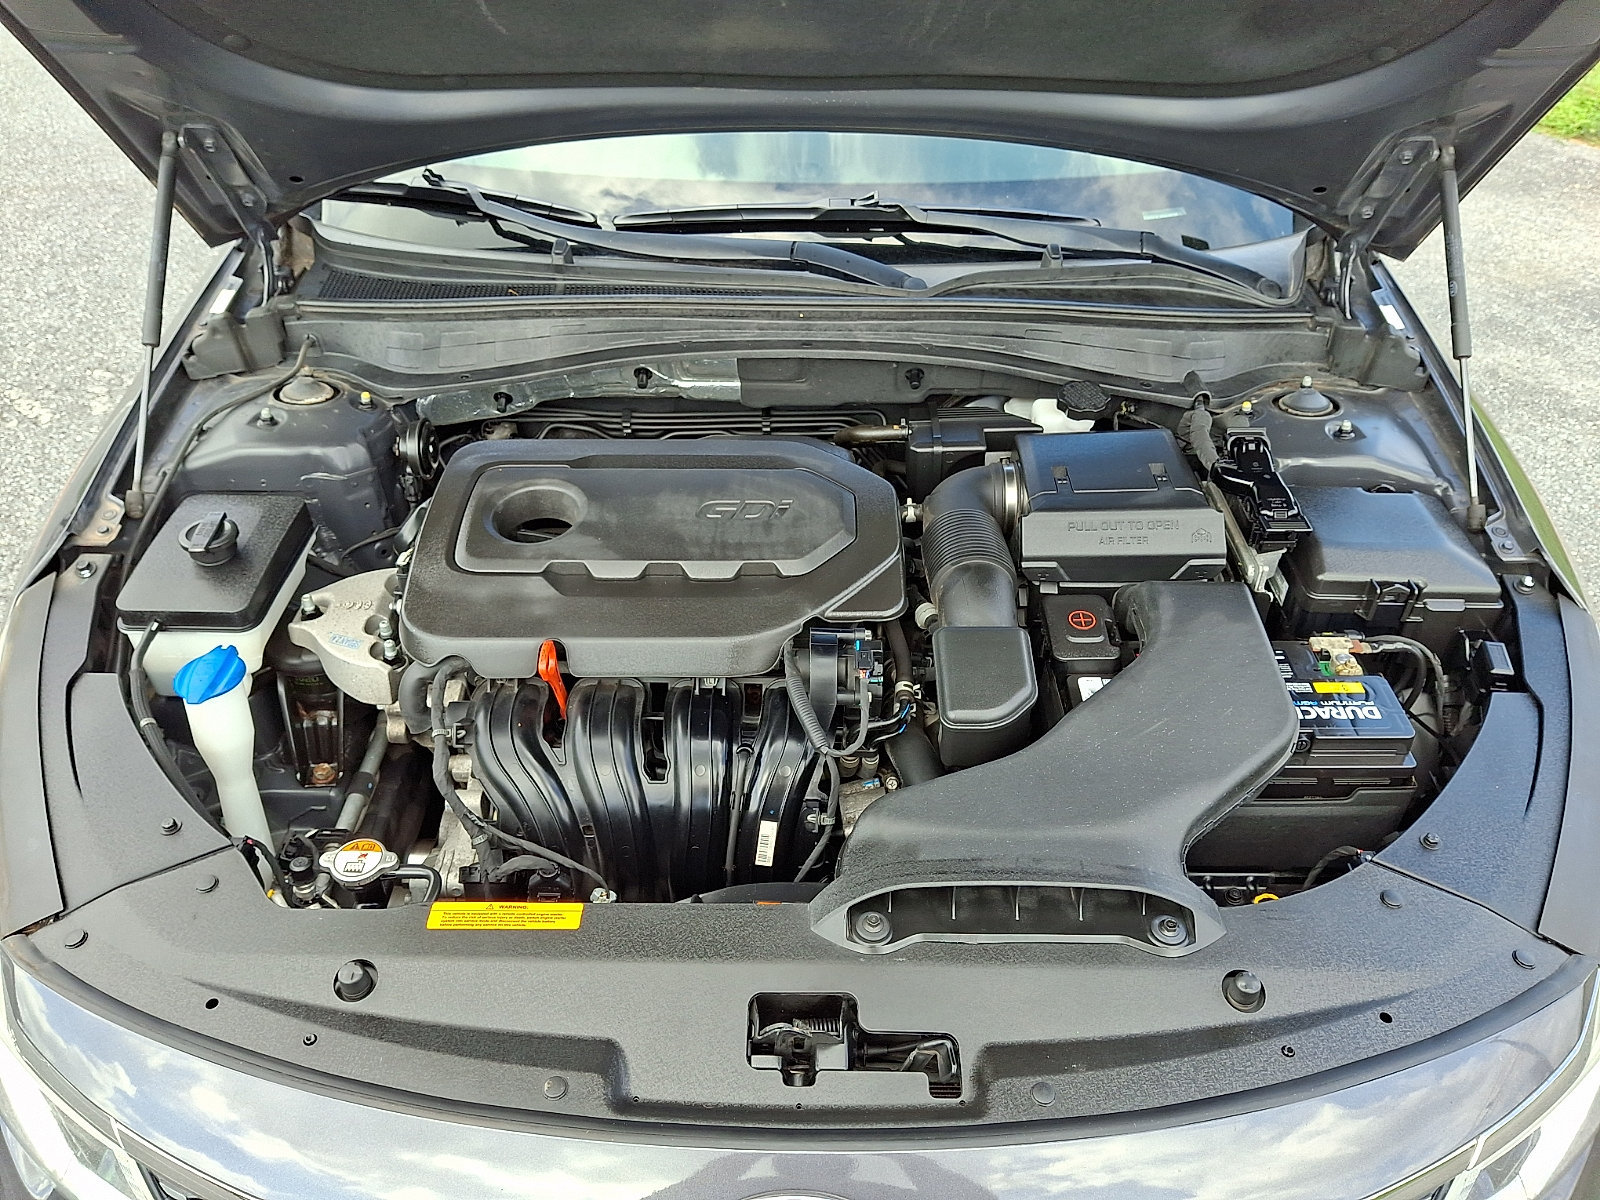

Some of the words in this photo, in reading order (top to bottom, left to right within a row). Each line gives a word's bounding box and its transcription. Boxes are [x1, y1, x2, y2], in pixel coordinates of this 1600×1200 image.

[1067, 520, 1098, 532] PULL
[1101, 520, 1125, 531] OUT
[1128, 520, 1145, 530] TO
[1147, 519, 1180, 530] OPEN
[1098, 536, 1115, 545] AIR
[1117, 535, 1149, 545] FILTER
